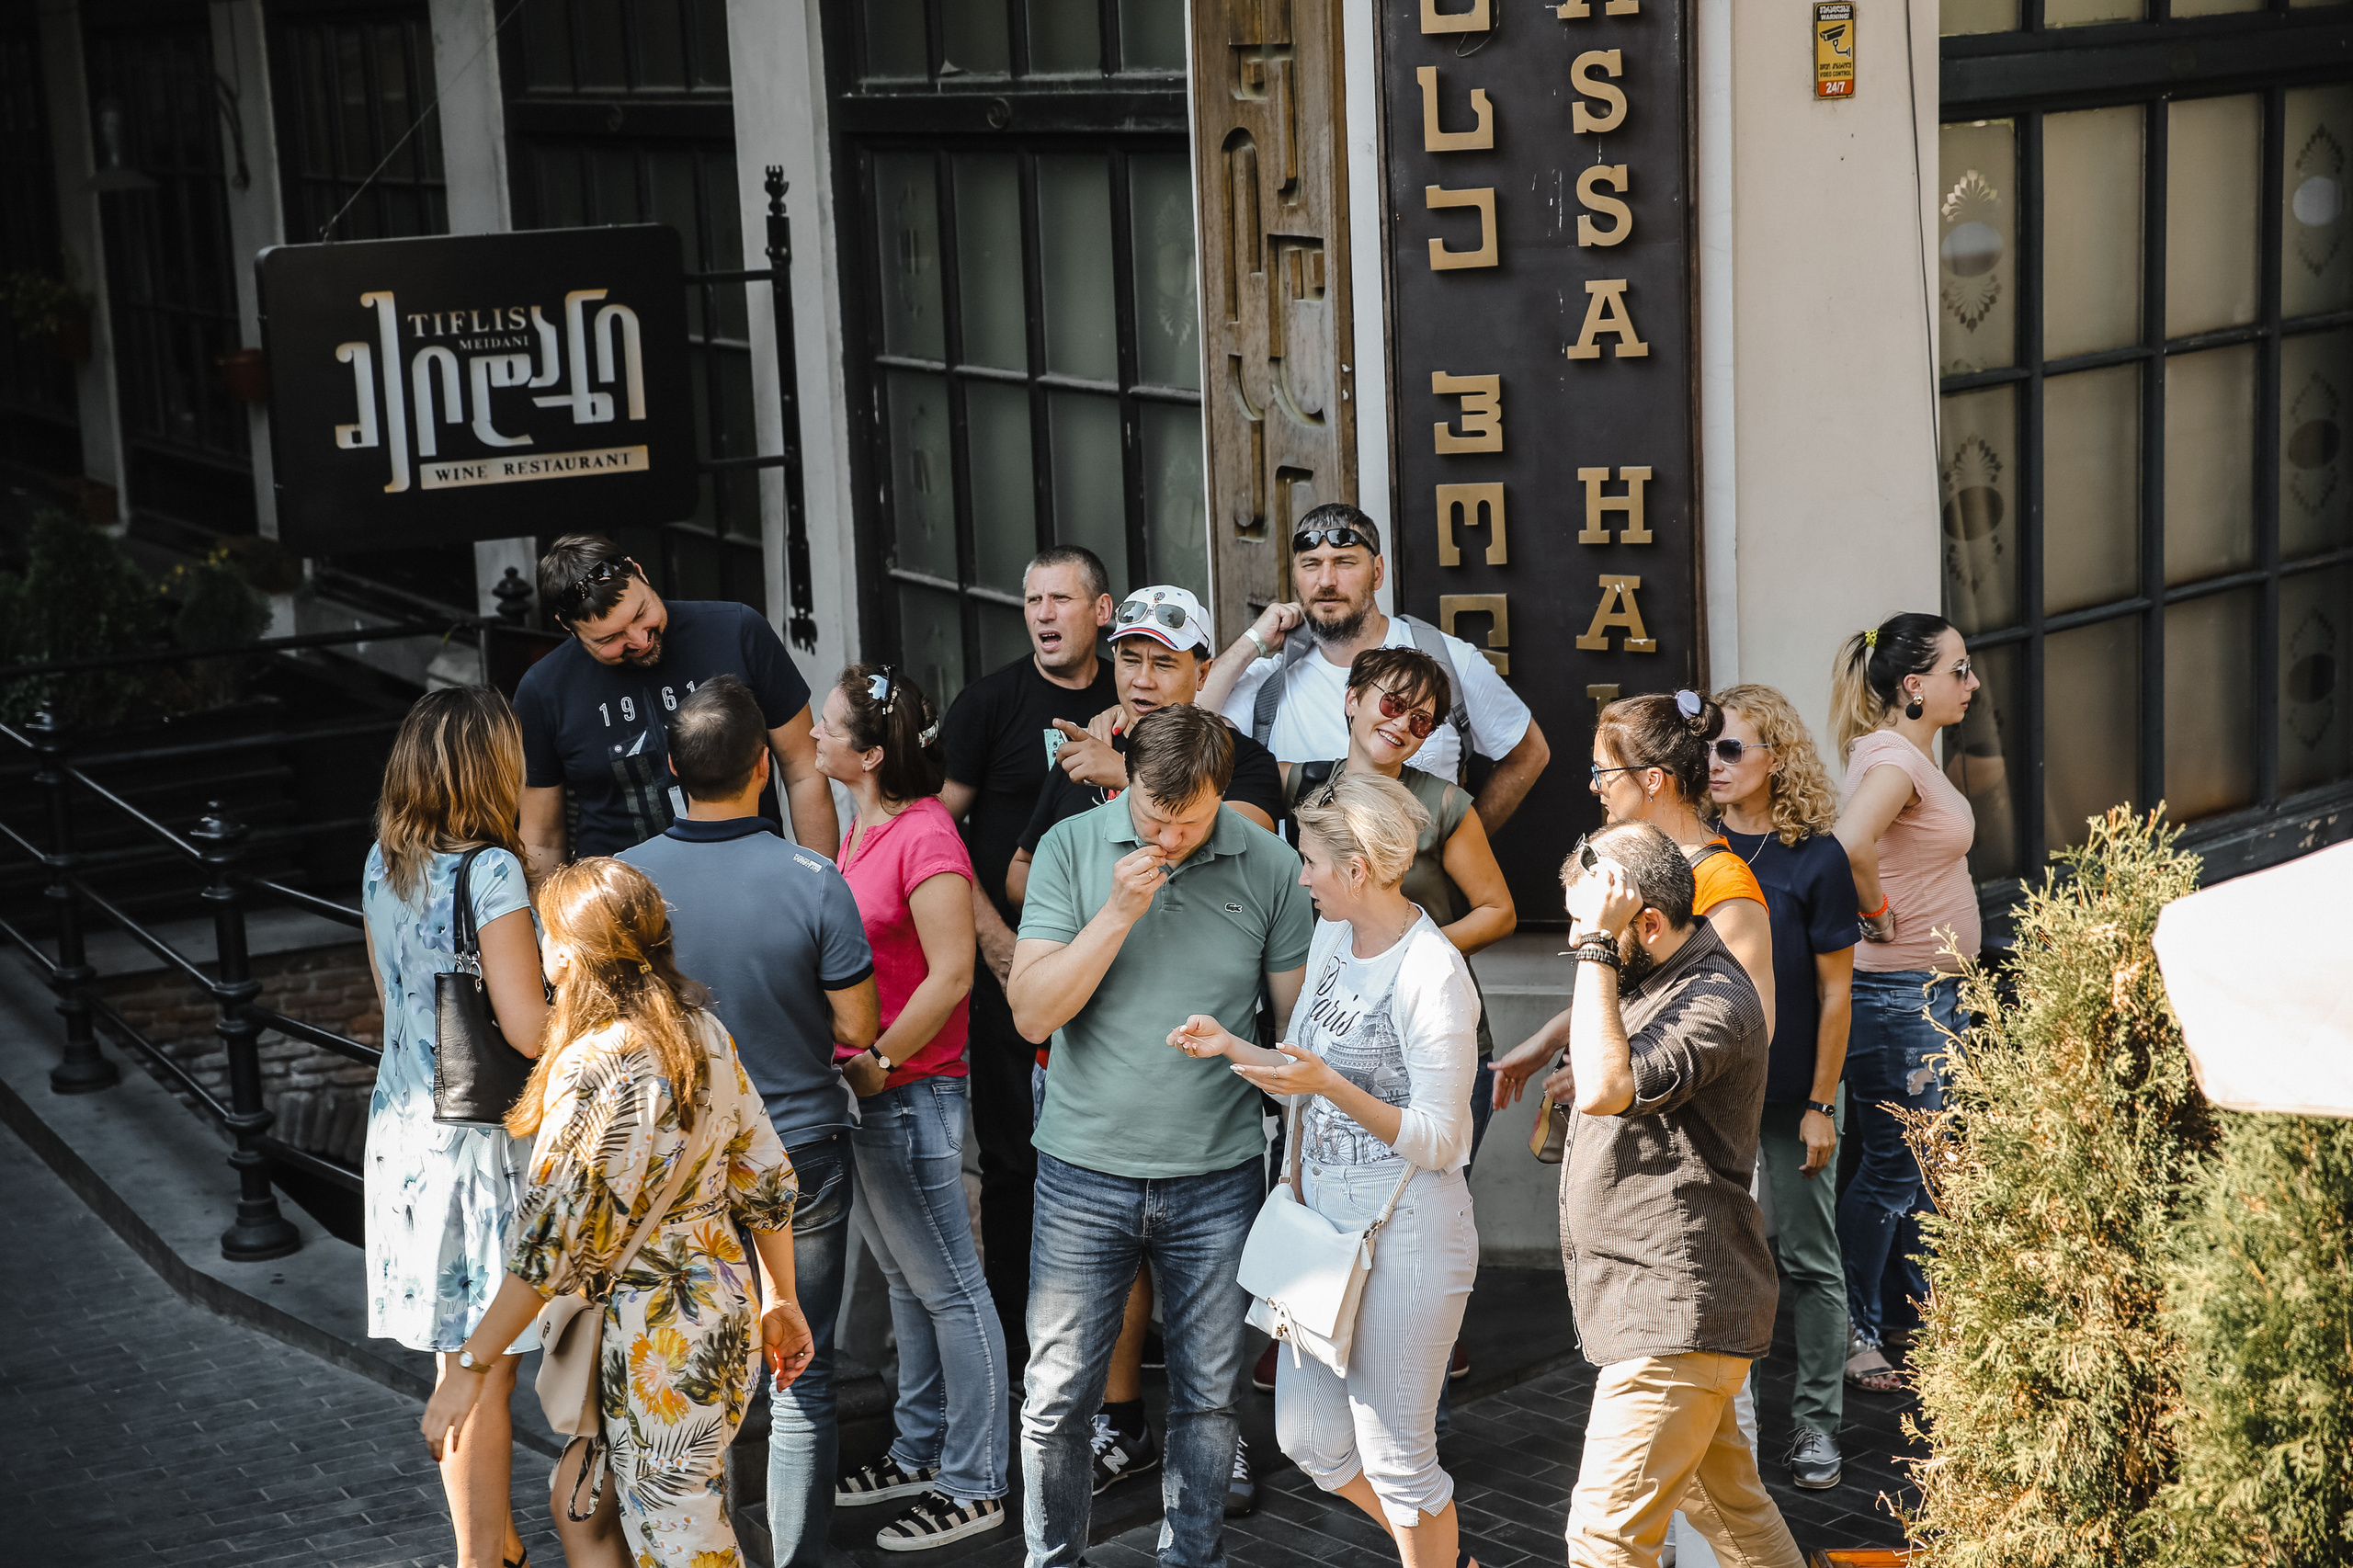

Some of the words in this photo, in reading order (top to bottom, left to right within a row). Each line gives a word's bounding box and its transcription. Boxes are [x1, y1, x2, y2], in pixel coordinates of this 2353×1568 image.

[1825, 81, 1846, 95] 24/7
[1556, 0, 1649, 359] SSA
[407, 306, 528, 337] TIFLIS
[460, 335, 529, 351] MEIDANI
[435, 464, 488, 482] WINE
[505, 451, 631, 476] RESTAURANT
[1575, 465, 1656, 722] HA
[1310, 955, 1360, 1037] Paris
